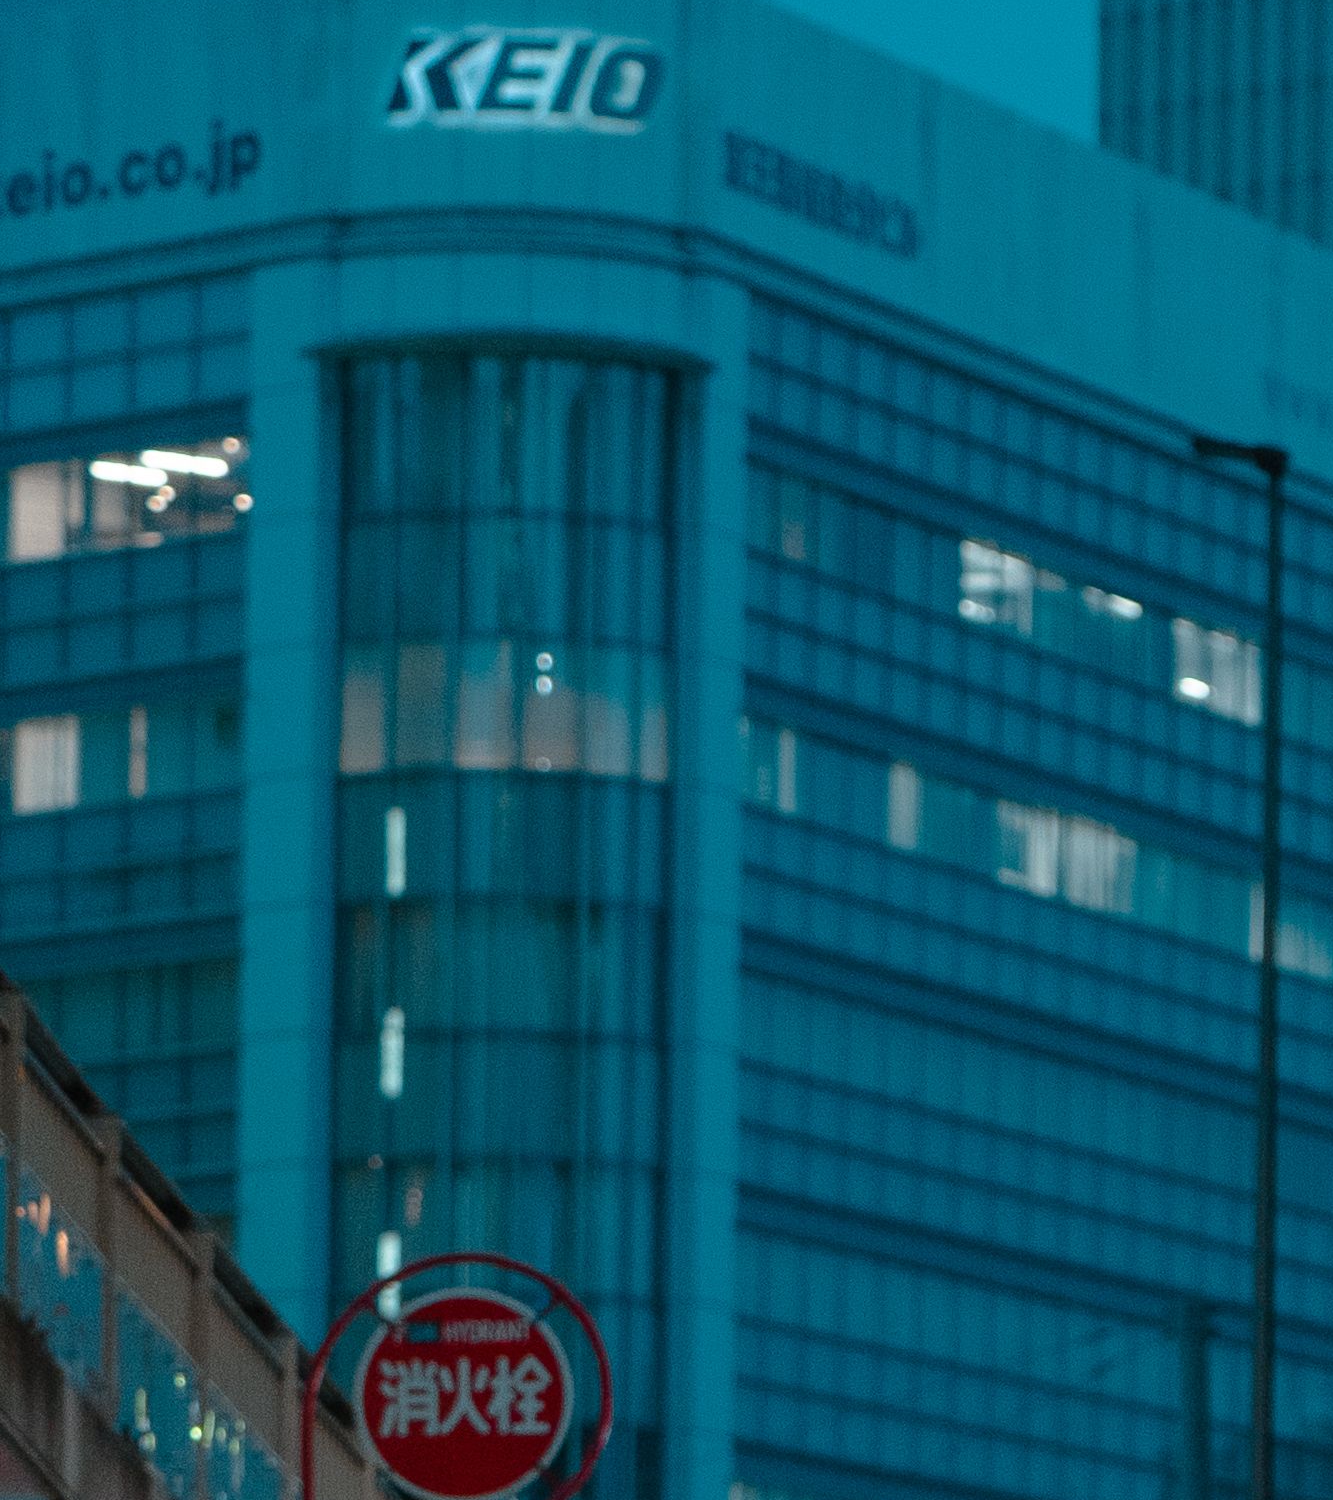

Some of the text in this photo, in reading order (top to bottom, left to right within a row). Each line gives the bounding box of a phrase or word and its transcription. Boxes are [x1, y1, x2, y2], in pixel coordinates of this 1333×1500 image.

[387, 26, 668, 130] KEIO
[377, 1353, 554, 1439] 消火栓
